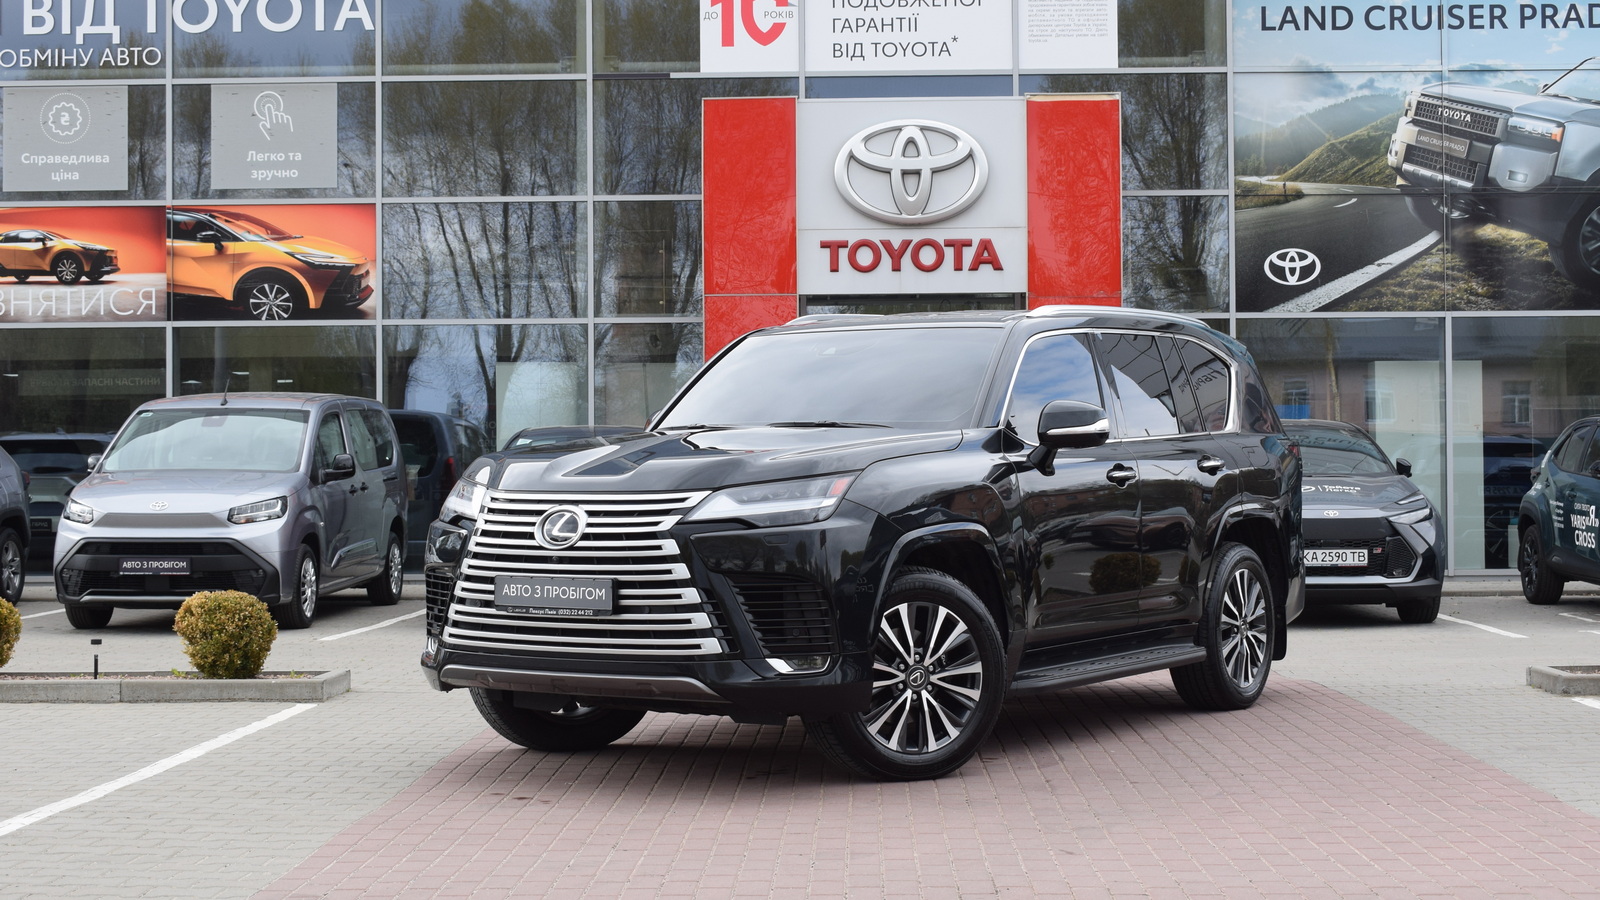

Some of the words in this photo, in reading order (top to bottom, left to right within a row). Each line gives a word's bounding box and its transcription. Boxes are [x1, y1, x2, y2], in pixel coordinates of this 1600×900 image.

[23, 0, 120, 44] ВІД
[703, 12, 719, 21] ДО
[763, 10, 794, 19] РОКІВ
[832, 13, 919, 33] ГАРАНТІЇ
[1260, 5, 1353, 31] LAND
[1364, 4, 1509, 31] CRUISER
[0, 48, 93, 67] ОБМІНУ
[100, 47, 162, 67] АВТО
[832, 43, 865, 61] ВІД
[1438, 108, 1471, 122] TOYOTA
[21, 151, 110, 165] Справедлива
[247, 151, 285, 163] Легко
[287, 151, 302, 161] та
[51, 168, 80, 182] ціна
[251, 168, 299, 181] зручно
[820, 238, 1004, 272] TOYOTA
[1570, 514, 1586, 530] YARIS
[1574, 530, 1596, 549] CROSS
[1321, 551, 1348, 562] 2590
[122, 561, 141, 569] АВТО
[148, 561, 187, 569] ПРОБІГОМ
[502, 584, 532, 597] АВТО
[544, 586, 606, 600] ПРОБІГОМ
